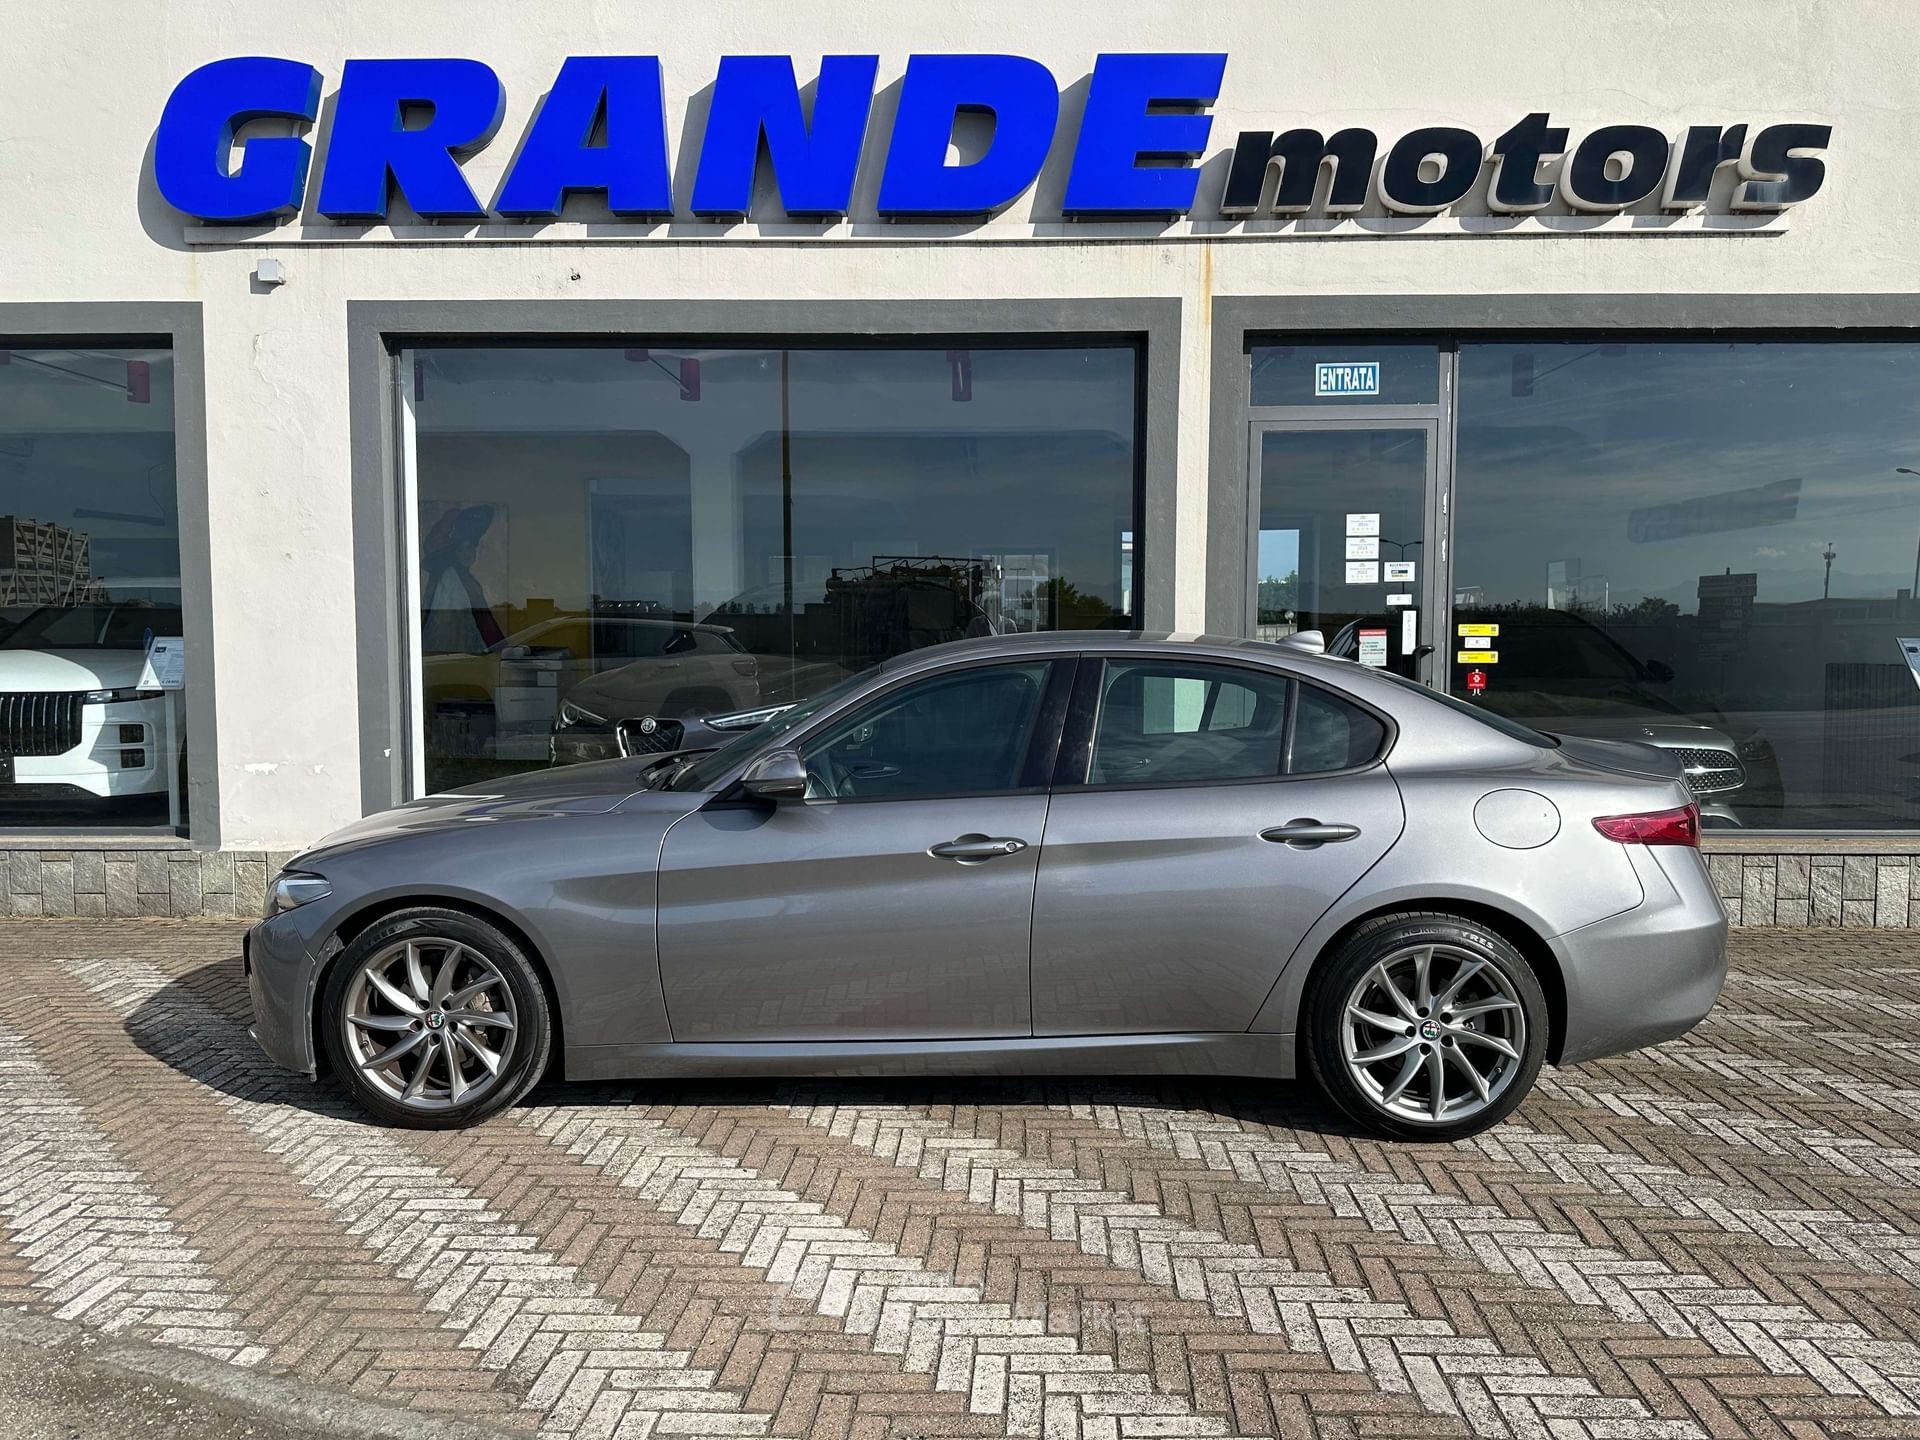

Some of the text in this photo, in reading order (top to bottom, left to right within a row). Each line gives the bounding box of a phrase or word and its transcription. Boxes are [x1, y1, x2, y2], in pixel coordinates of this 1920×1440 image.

[154, 52, 1833, 221] GRANDE motors
[1320, 367, 1375, 391] ENTRATA
